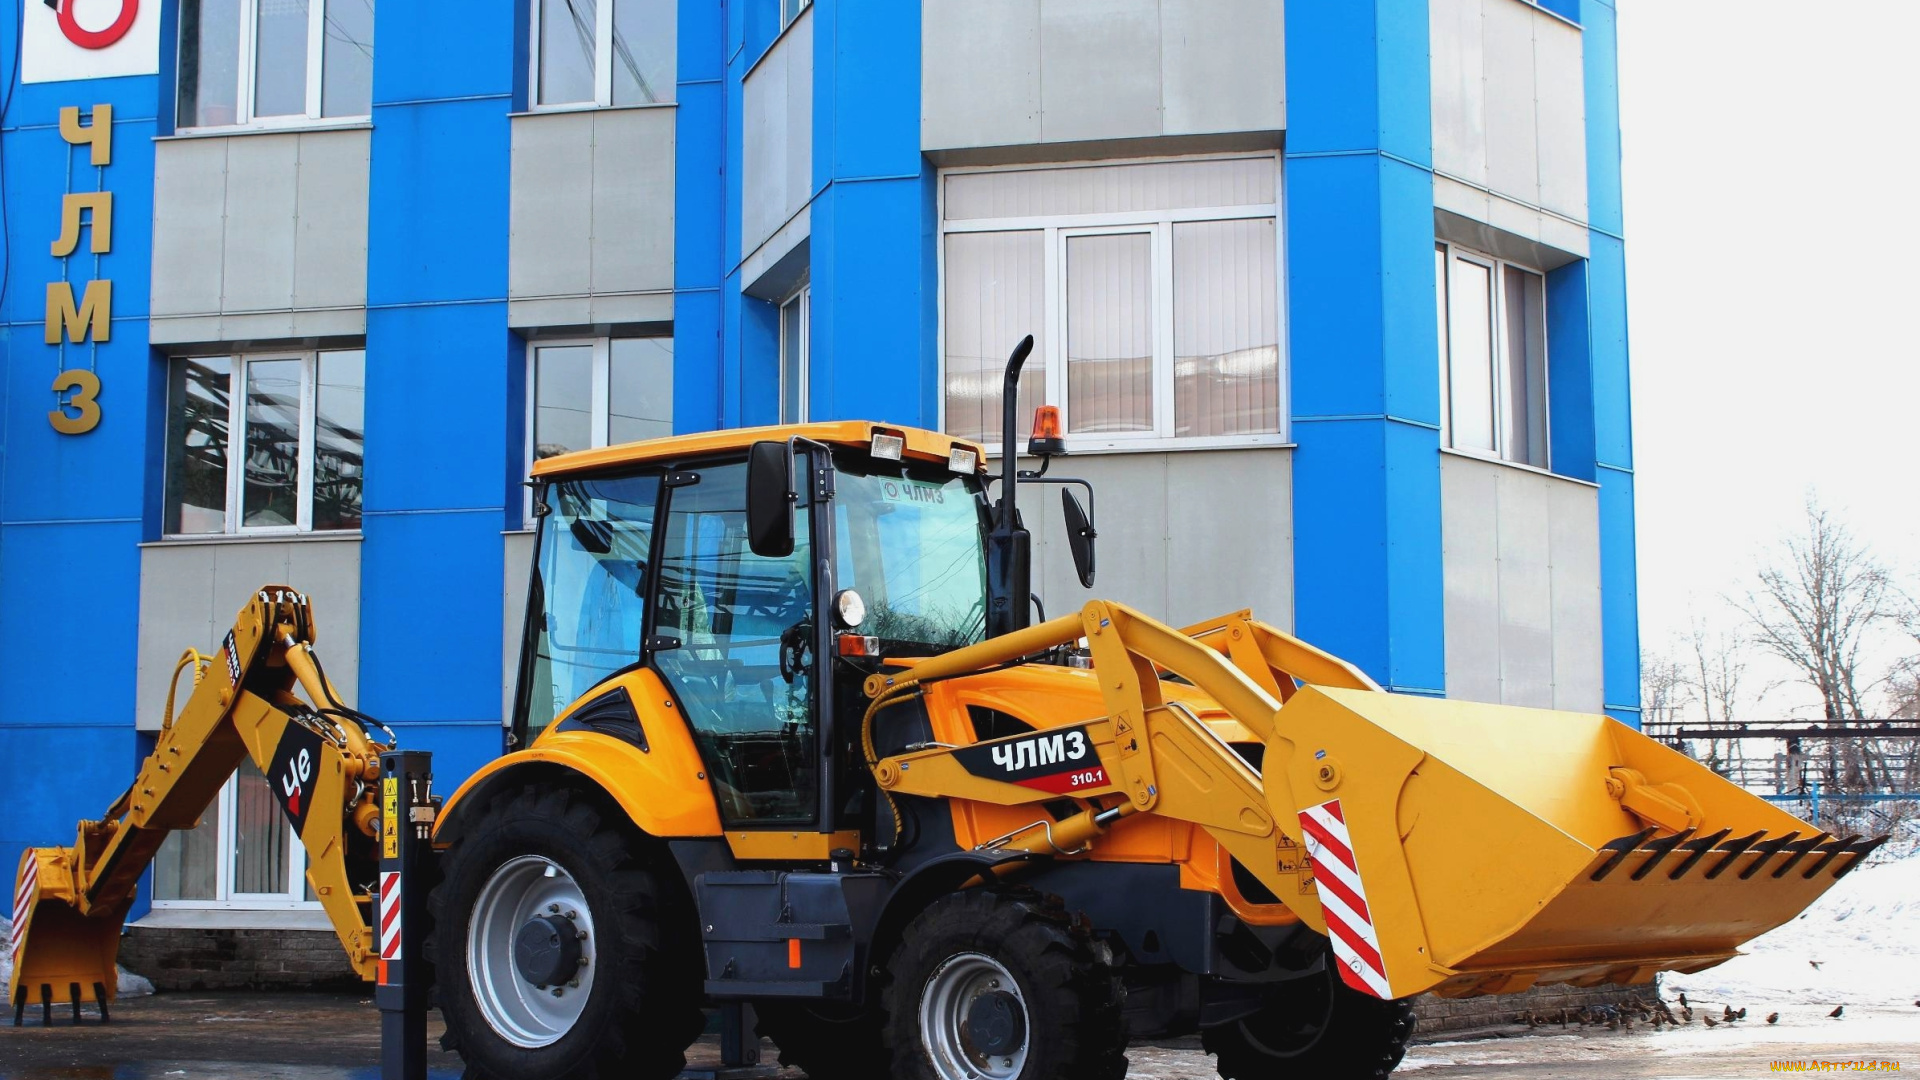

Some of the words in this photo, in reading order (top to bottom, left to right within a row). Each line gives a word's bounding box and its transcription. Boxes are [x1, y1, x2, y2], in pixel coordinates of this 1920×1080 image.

[45, 103, 112, 434] ЧЛМЗ
[902, 484, 944, 504] ЧЛМЗ
[991, 731, 1086, 772] ЧЛМЗ
[1071, 770, 1103, 786] 310.1
